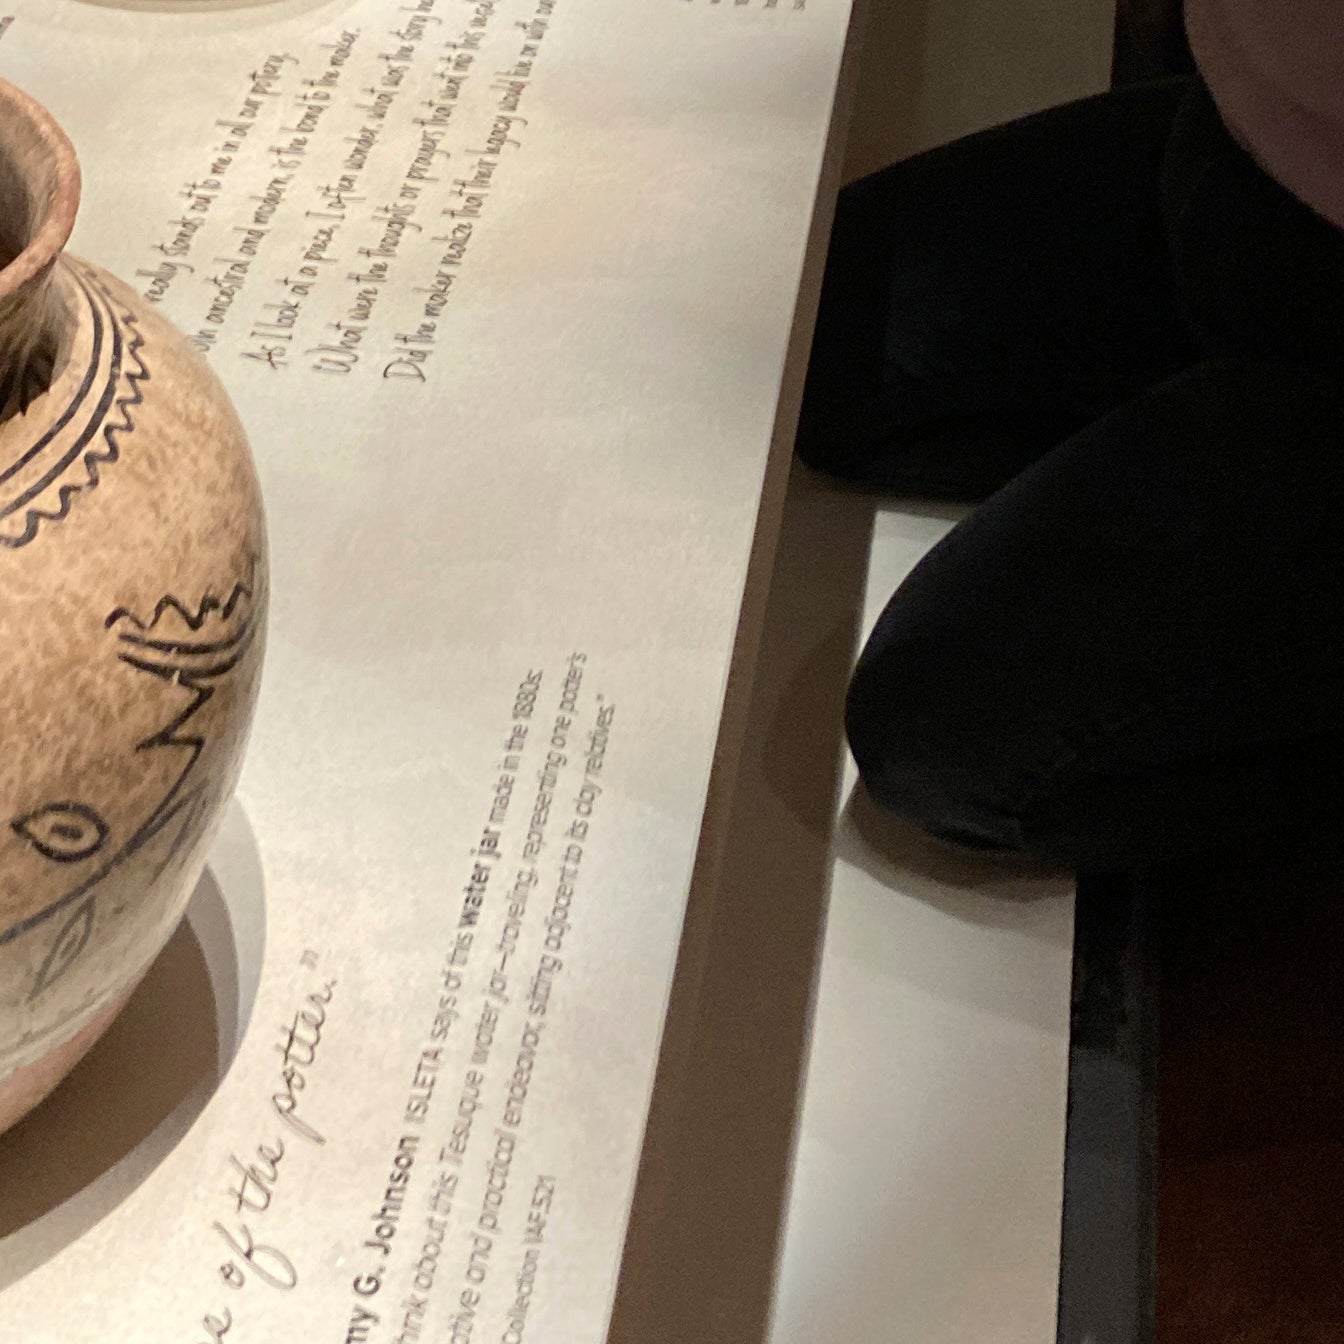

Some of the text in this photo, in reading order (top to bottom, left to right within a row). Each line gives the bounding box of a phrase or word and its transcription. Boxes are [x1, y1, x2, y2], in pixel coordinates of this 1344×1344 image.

[388, 14, 443, 41] story
[443, 30, 486, 50] this
[376, 45, 414, 62] the
[381, 66, 409, 86] was
[433, 73, 468, 99] went
[238, 97, 263, 117] our
[354, 88, 399, 119] what
[412, 101, 456, 126] that
[214, 119, 254, 137] all
[213, 141, 240, 152] in
[404, 130, 451, 181] prayers
[210, 156, 232, 174] me
[183, 178, 221, 189] to
[316, 174, 366, 209] often
[398, 183, 421, 198] or
[178, 191, 217, 212] out
[304, 211, 345, 219] I
[150, 216, 204, 256] stands
[356, 203, 423, 257] thoughts
[135, 261, 195, 302] really
[276, 277, 314, 295] at
[298, 265, 318, 277] a
[346, 262, 388, 283] the
[254, 300, 301, 327] look
[348, 287, 378, 320] were
[248, 330, 293, 340] I
[304, 323, 368, 374] What
[239, 344, 288, 369] As
[504, 724, 528, 751] the
[496, 755, 520, 771] in
[488, 775, 515, 823] made
[573, 780, 602, 817] clay
[469, 826, 501, 860] jar
[564, 820, 589, 842] its
[562, 846, 583, 864] to
[458, 862, 490, 928] water
[543, 866, 578, 950] adjacent
[446, 932, 474, 966] this
[441, 971, 462, 991] of
[527, 954, 562, 1016] sitting
[429, 995, 459, 1041] says
[403, 1047, 443, 1122] ISLETA
[228, 1137, 284, 1212] the
[478, 1128, 516, 1234] practical
[363, 1135, 420, 1255] Johnson
[212, 1221, 297, 1290] of
[464, 1233, 493, 1283] and
[352, 1266, 385, 1296] G.
[344, 1305, 379, 1344] my
[391, 1293, 429, 1344] hink
[448, 1288, 481, 1344] ative
